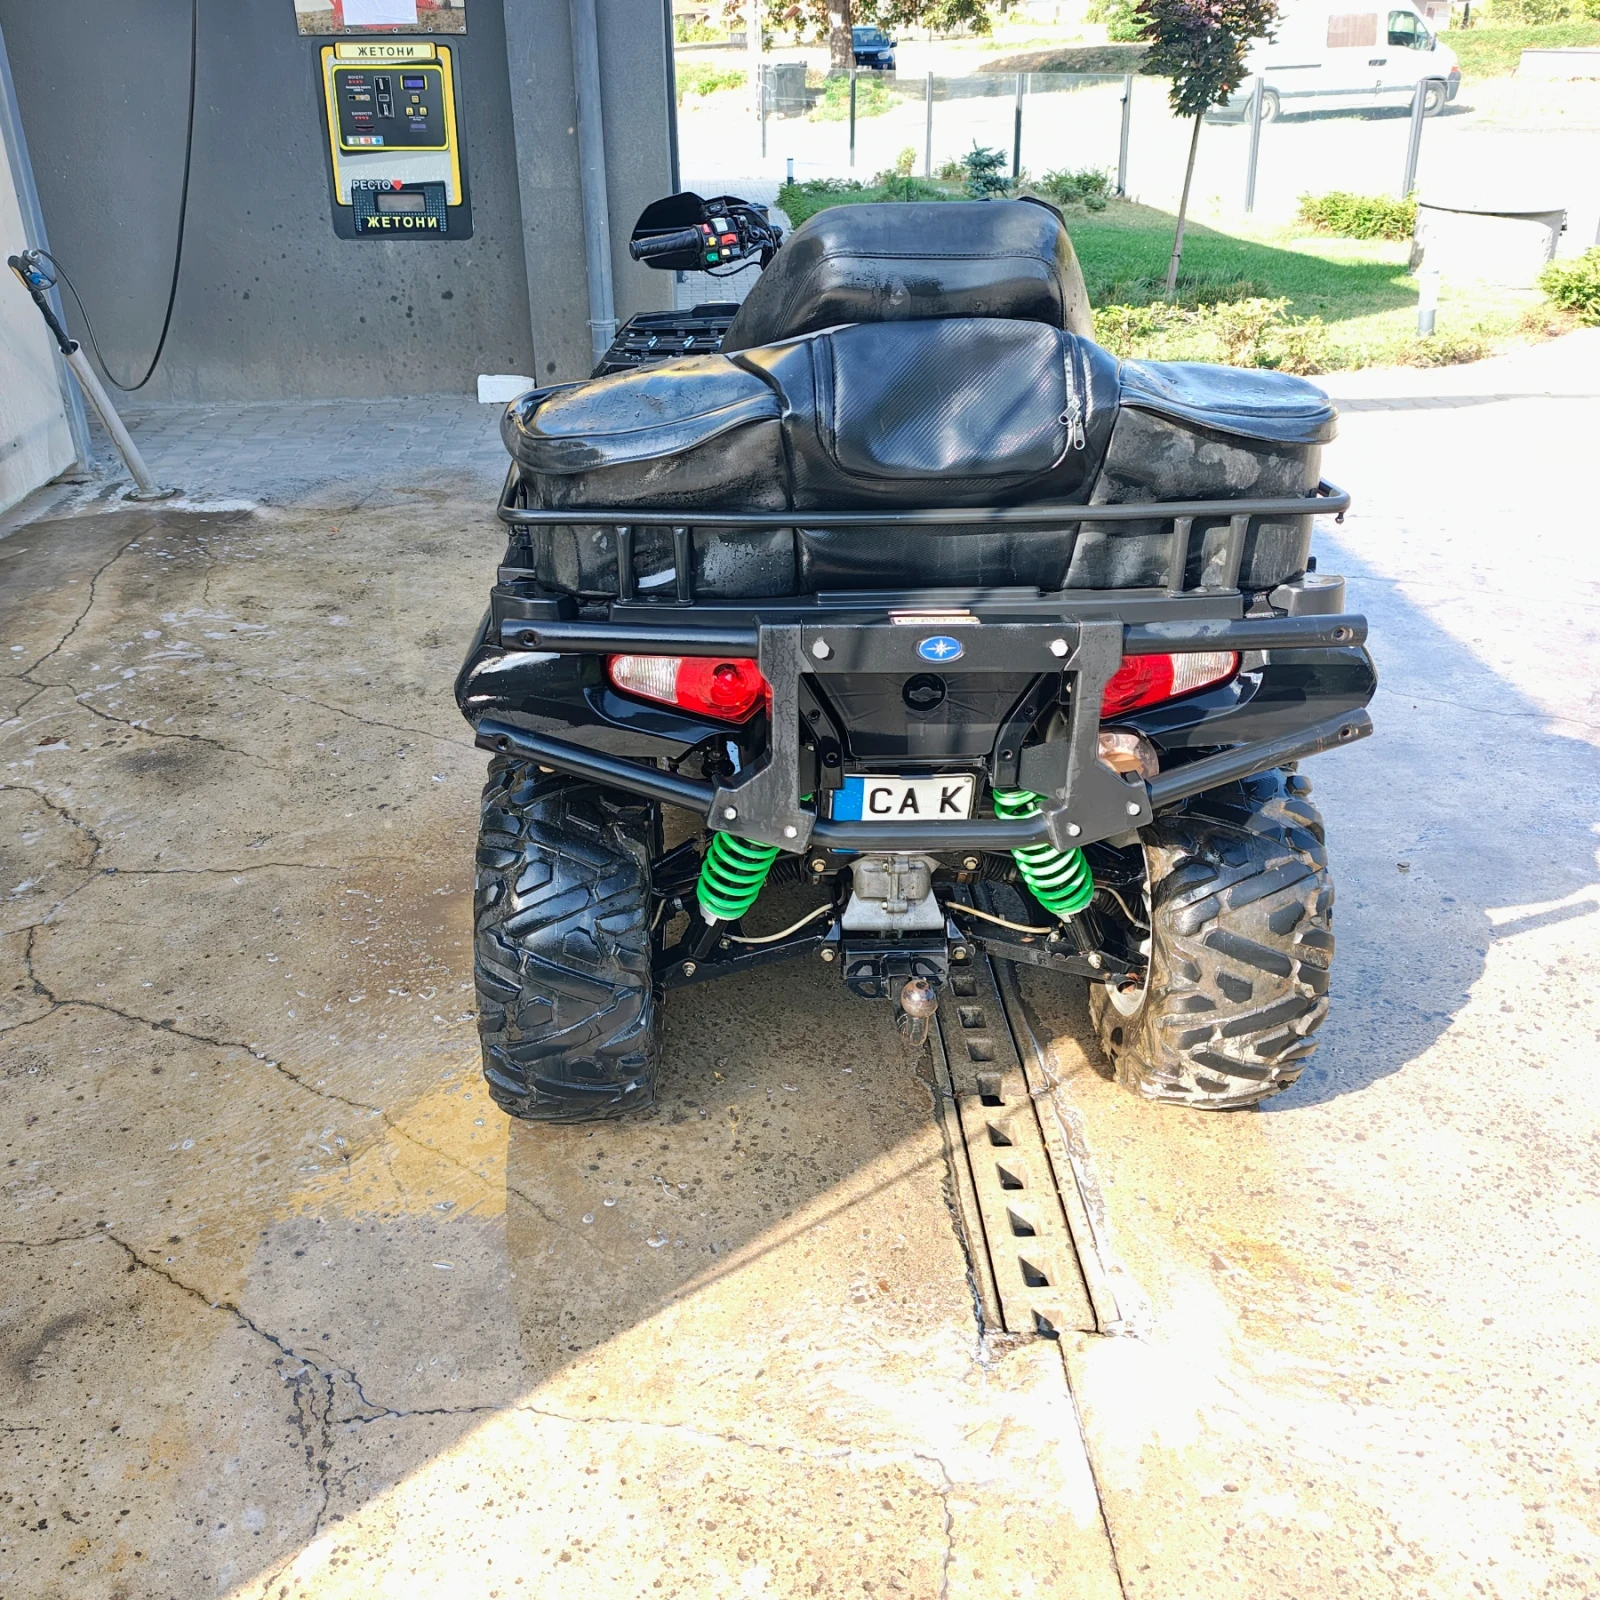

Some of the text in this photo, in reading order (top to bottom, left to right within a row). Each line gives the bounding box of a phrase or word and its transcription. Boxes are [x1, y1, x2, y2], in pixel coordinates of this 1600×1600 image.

[357, 46, 414, 56] ЖЕТОНИ
[352, 180, 391, 190] РЕСТО
[366, 216, 438, 228] ЖЕТОНИ
[939, 786, 965, 813] K
